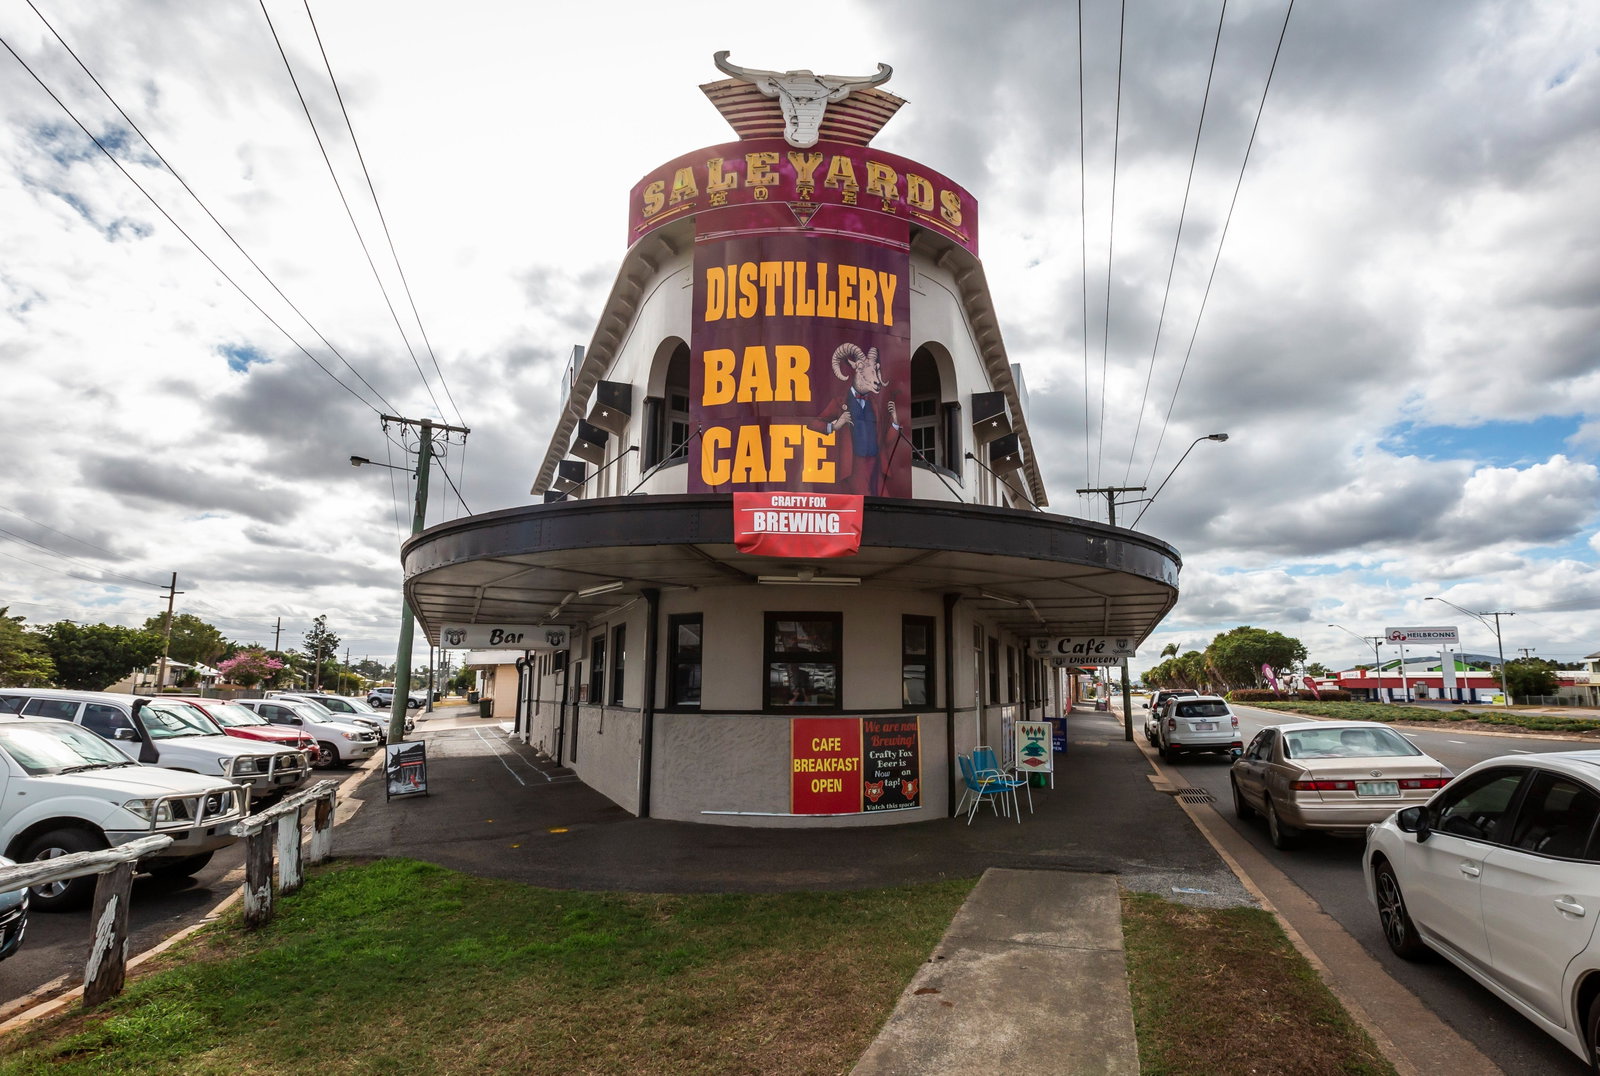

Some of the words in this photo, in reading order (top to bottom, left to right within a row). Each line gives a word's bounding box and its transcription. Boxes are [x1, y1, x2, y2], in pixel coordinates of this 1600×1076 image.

[641, 150, 963, 227] SALEYARDS
[710, 186, 897, 213] HOTEL
[704, 261, 898, 327] DISTILLERY
[702, 345, 812, 407] BAR
[701, 424, 836, 486] CAFE
[771, 495, 806, 508] CRAFTY
[808, 496, 827, 508] FOX
[753, 512, 840, 533] BREWING
[489, 628, 524, 645] Bar
[1057, 638, 1106, 656] Café
[864, 721, 881, 733] We
[882, 723, 899, 733] are
[811, 737, 841, 751] CAFE
[872, 734, 915, 748] Brewing!
[869, 750, 897, 760] Crafty
[899, 749, 913, 758] Fox
[793, 757, 859, 773] BREAKFAST
[877, 760, 898, 768] Beer
[899, 758, 907, 767] is
[874, 770, 890, 778] Now
[811, 778, 842, 793] OPEN
[884, 777, 900, 788] tap!
